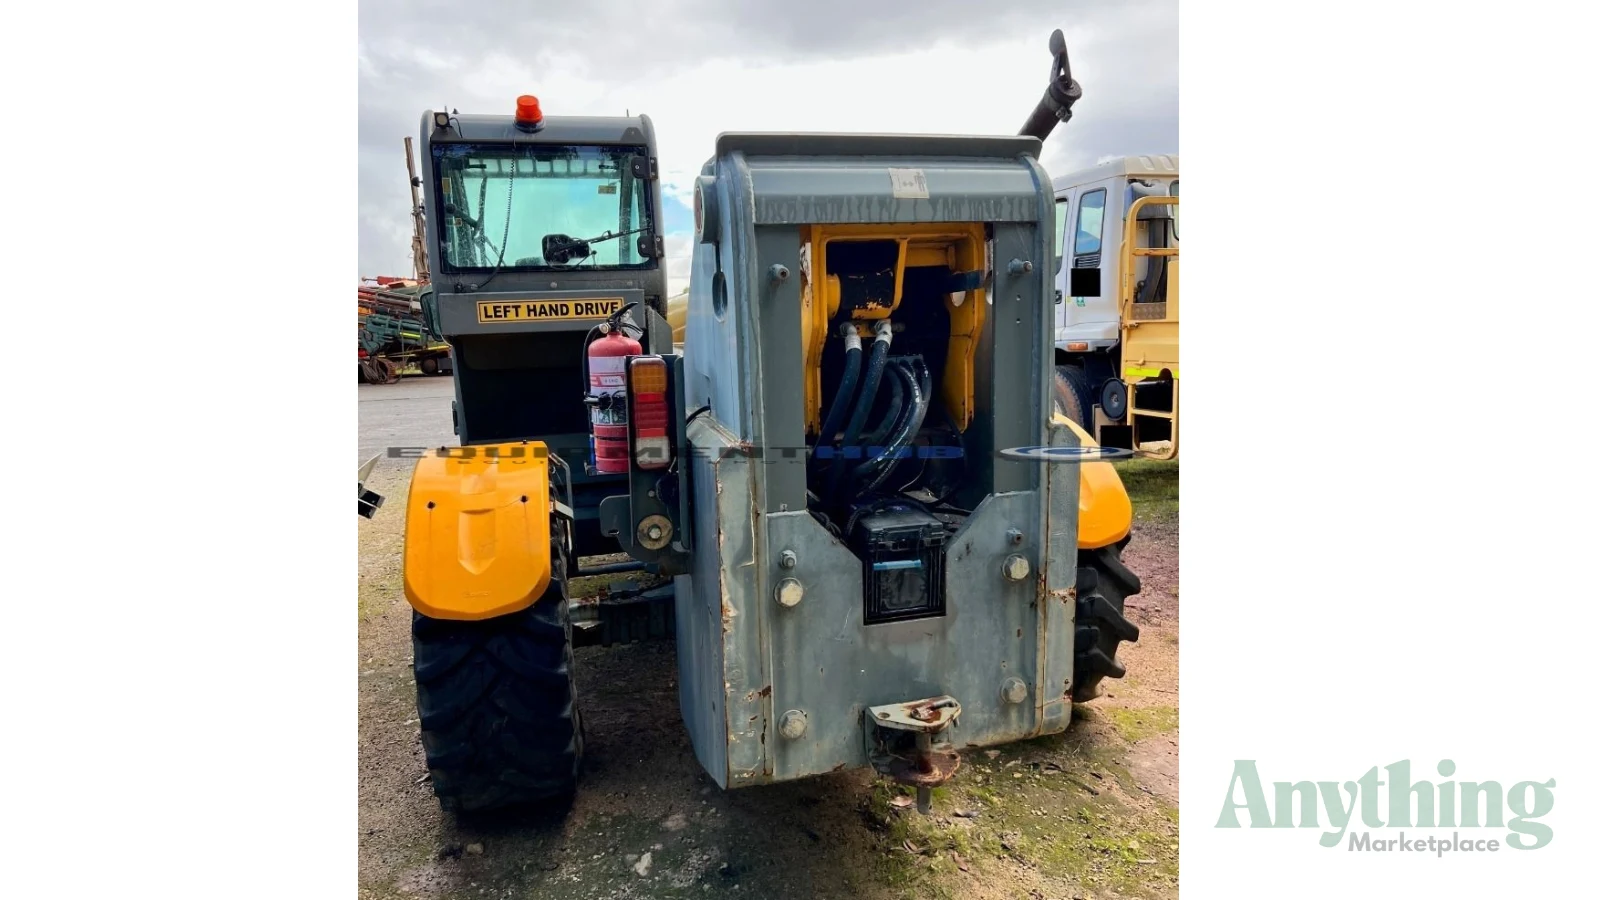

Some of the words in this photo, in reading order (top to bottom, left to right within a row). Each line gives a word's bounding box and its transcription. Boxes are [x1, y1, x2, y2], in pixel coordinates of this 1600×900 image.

[483, 304, 522, 319] LEFT
[526, 303, 570, 317] HAND
[574, 301, 619, 316] DRIVE
